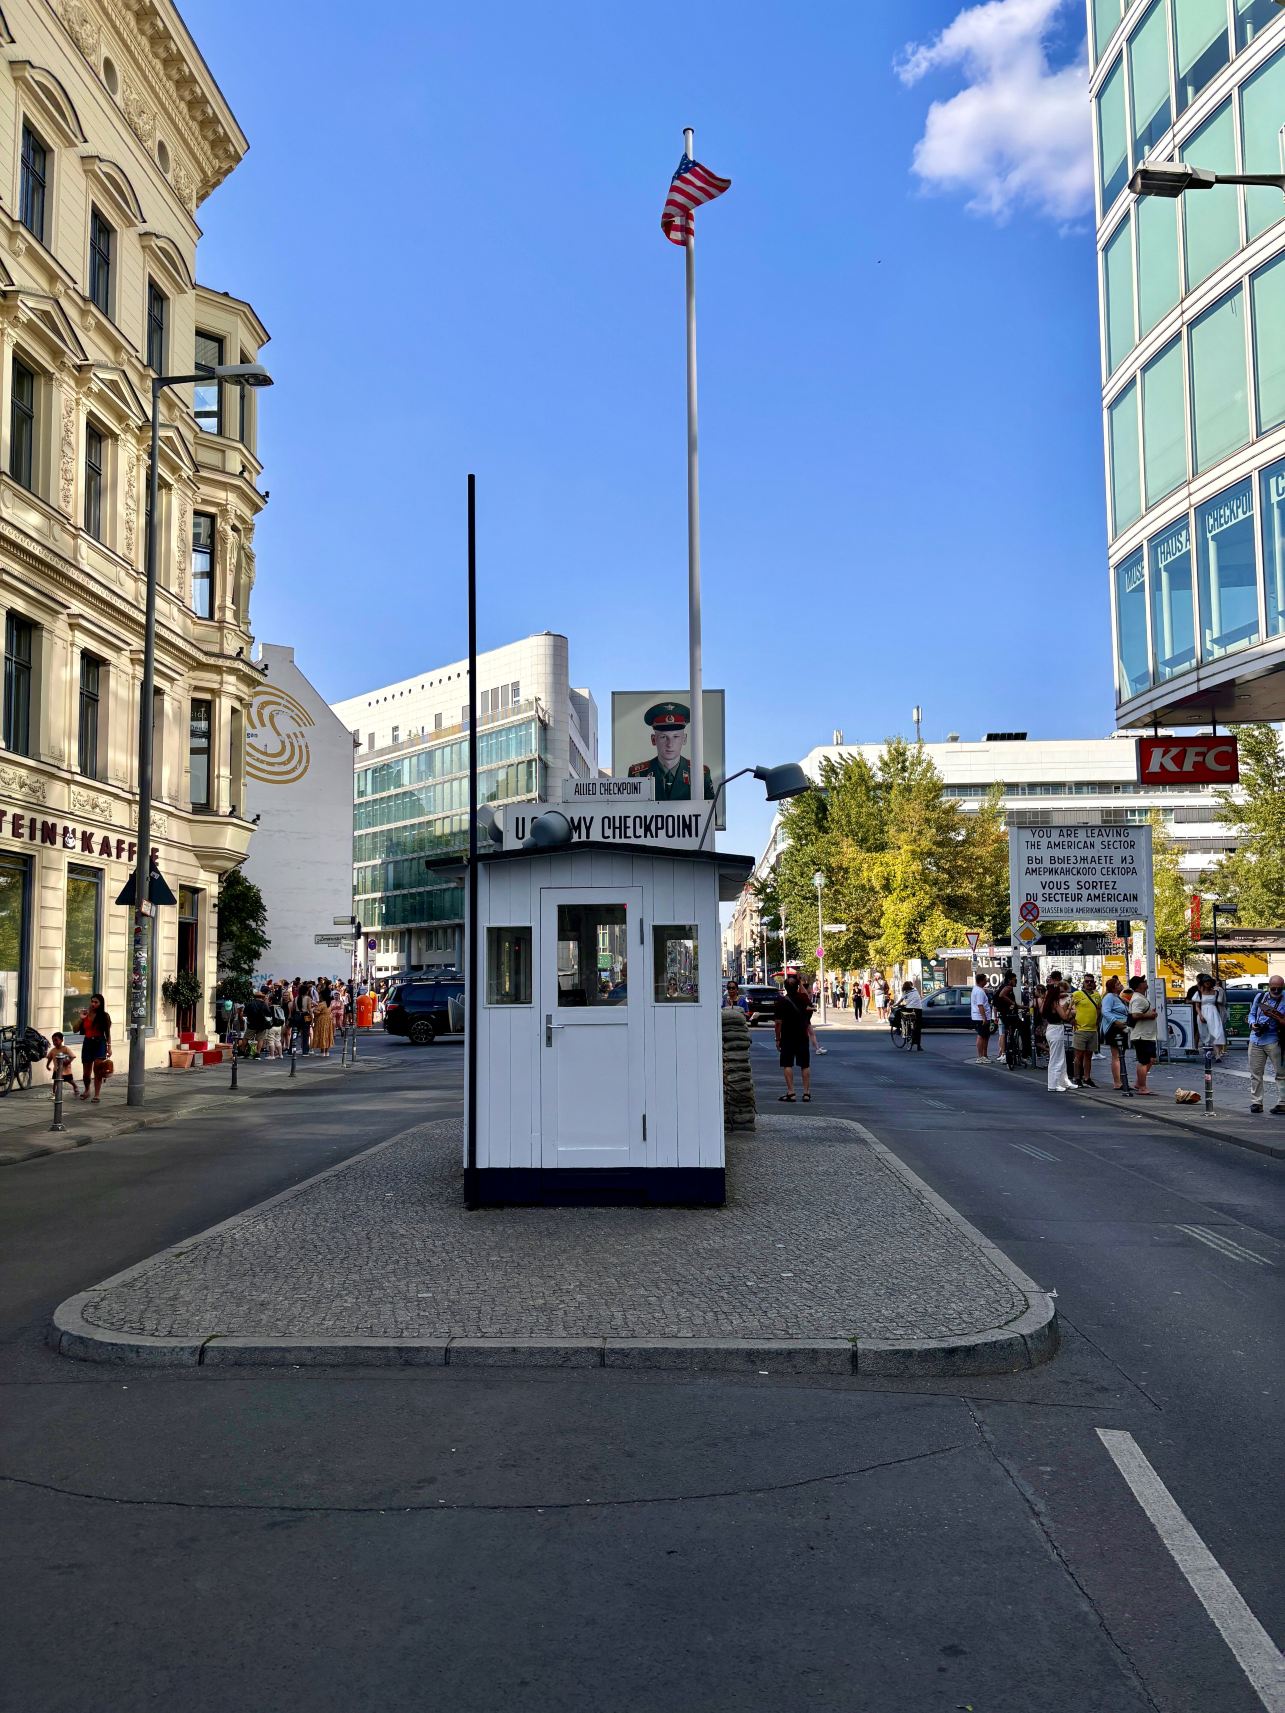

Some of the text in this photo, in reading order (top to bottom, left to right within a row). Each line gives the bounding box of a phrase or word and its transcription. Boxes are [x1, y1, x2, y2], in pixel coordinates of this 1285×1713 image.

[1160, 534, 1183, 565] HAUS
[1146, 746, 1233, 773] KFC
[574, 781, 643, 796] ALLIED CHECKPOINT
[570, 815, 594, 840] MY
[601, 813, 702, 840] CHECKPOINT
[1030, 828, 1130, 839] YOU ARE LEAVING
[81, 830, 160, 867] KAFFE
[1025, 840, 1136, 850] THE AMERICAN SECTOR
[1027, 855, 1135, 865] ВЫ ВЫЕЗЖАЕТЕ ИЗ
[1024, 866, 1138, 876] АМЕРИКАНСКОГО СЕКТОРА
[1040, 880, 1117, 890] VOUS SORTEZ
[1025, 892, 1038, 902] DU
[1041, 892, 1083, 902] SECTEUR
[1075, 906, 1118, 914] AMERIKANISCHEN
[1119, 906, 1139, 914] SEKTOR
